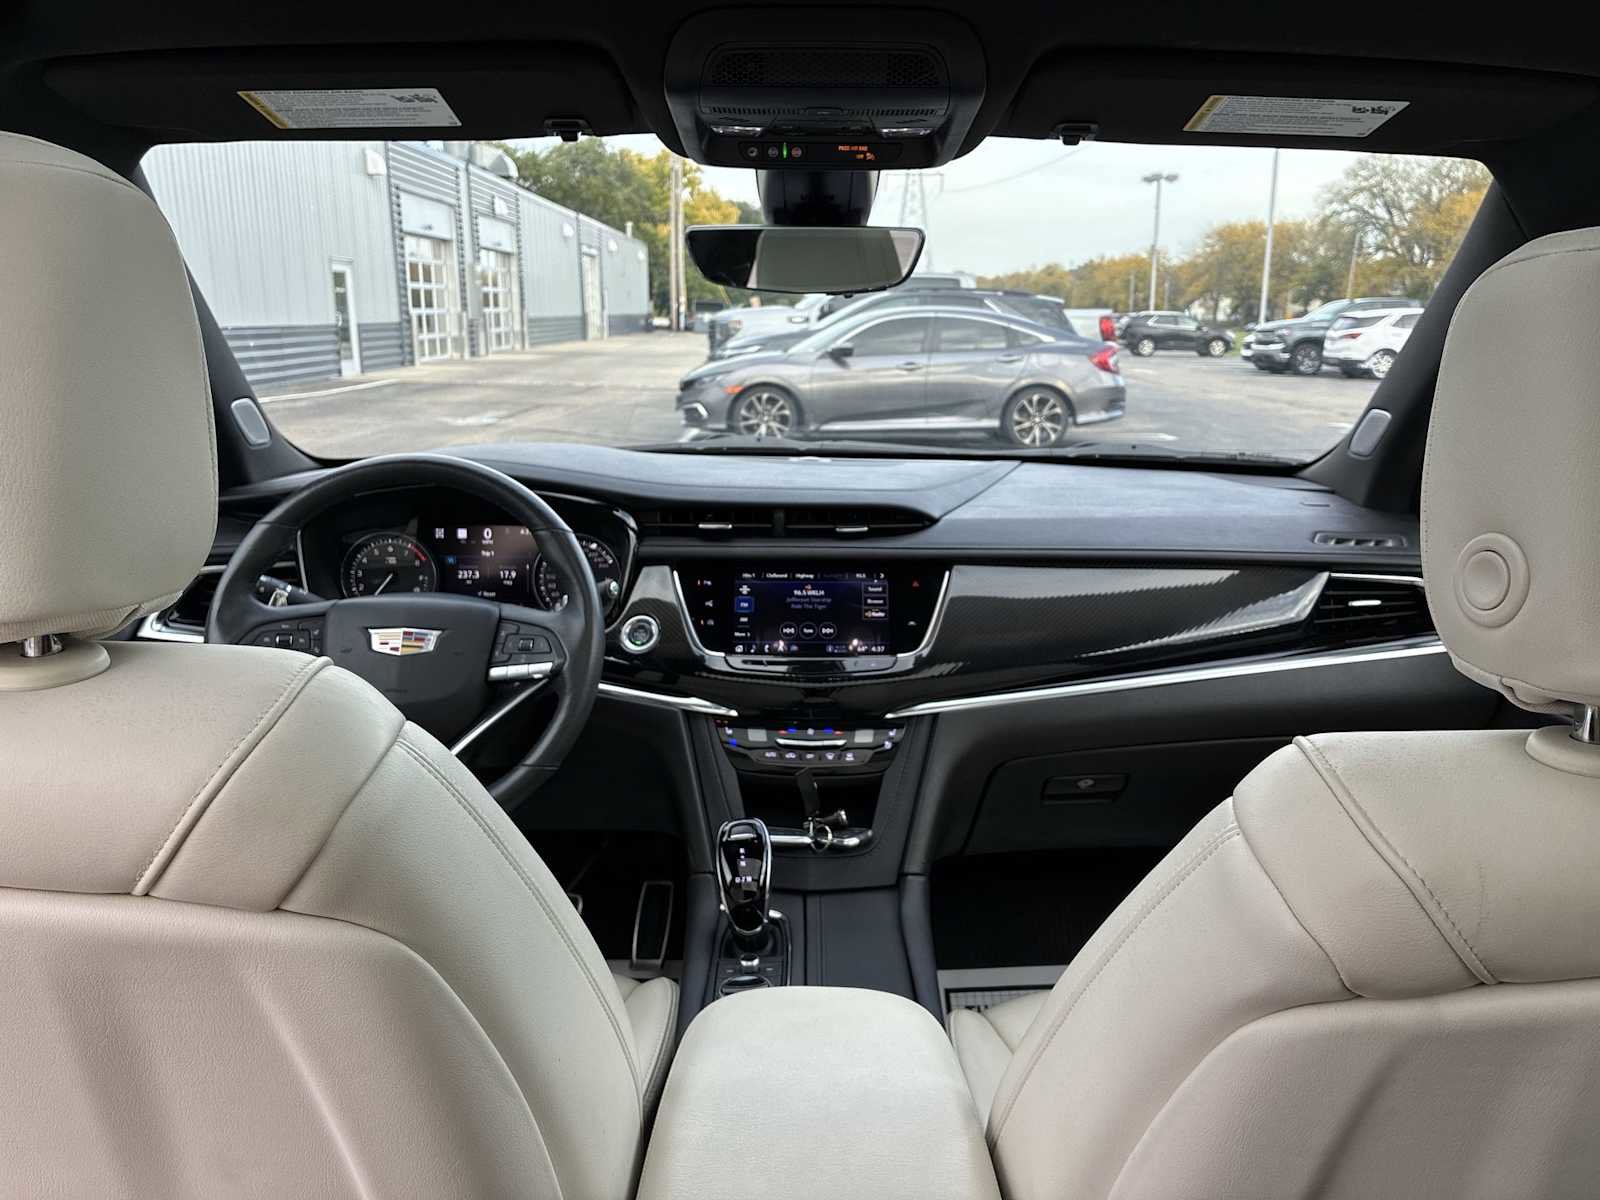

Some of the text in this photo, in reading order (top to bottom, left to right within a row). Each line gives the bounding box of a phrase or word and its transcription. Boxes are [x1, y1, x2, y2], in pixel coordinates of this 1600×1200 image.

[483, 527, 493, 539] 0
[458, 570, 480, 579] 237.3
[500, 570, 517, 579] 17.9
